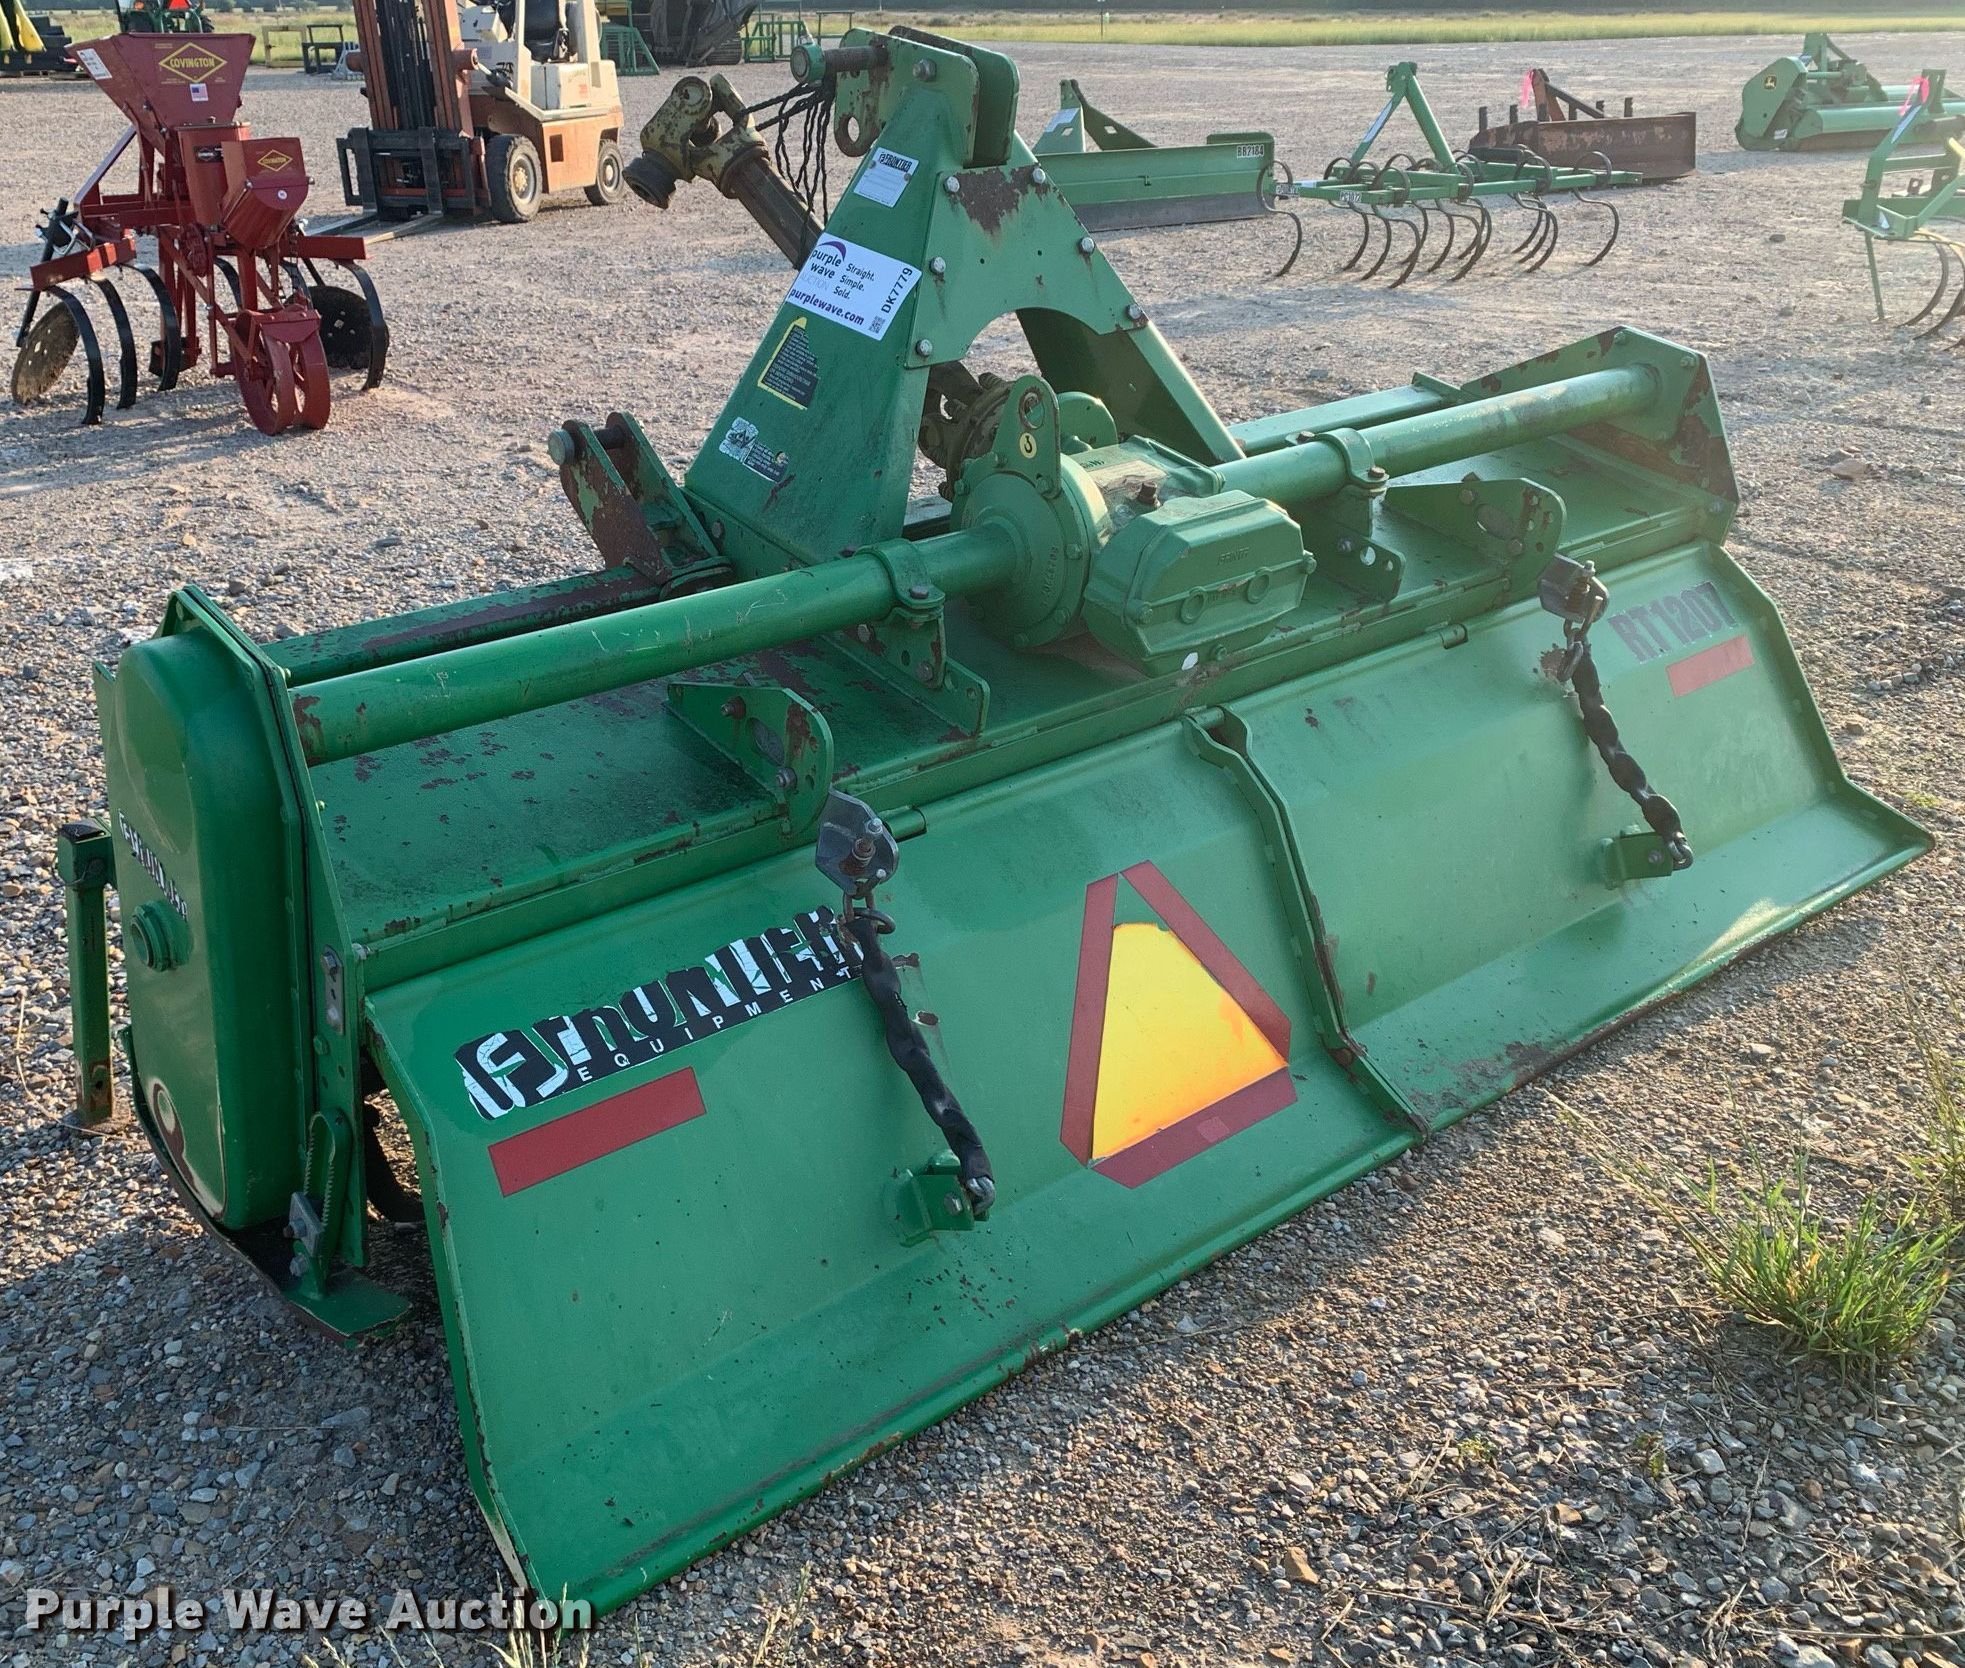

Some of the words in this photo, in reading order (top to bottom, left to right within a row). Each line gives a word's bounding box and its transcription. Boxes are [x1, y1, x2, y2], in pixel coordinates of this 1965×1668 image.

[169, 57, 215, 69] COVINGTON
[811, 250, 842, 267] purple
[811, 262, 836, 279] wave
[845, 263, 876, 282] Straight.
[839, 274, 865, 292] Simple.
[881, 267, 914, 314] DK7779
[833, 285, 851, 300] Sold.
[789, 287, 865, 326] purplewave.com
[577, 966, 853, 1083] EQUIPMENT
